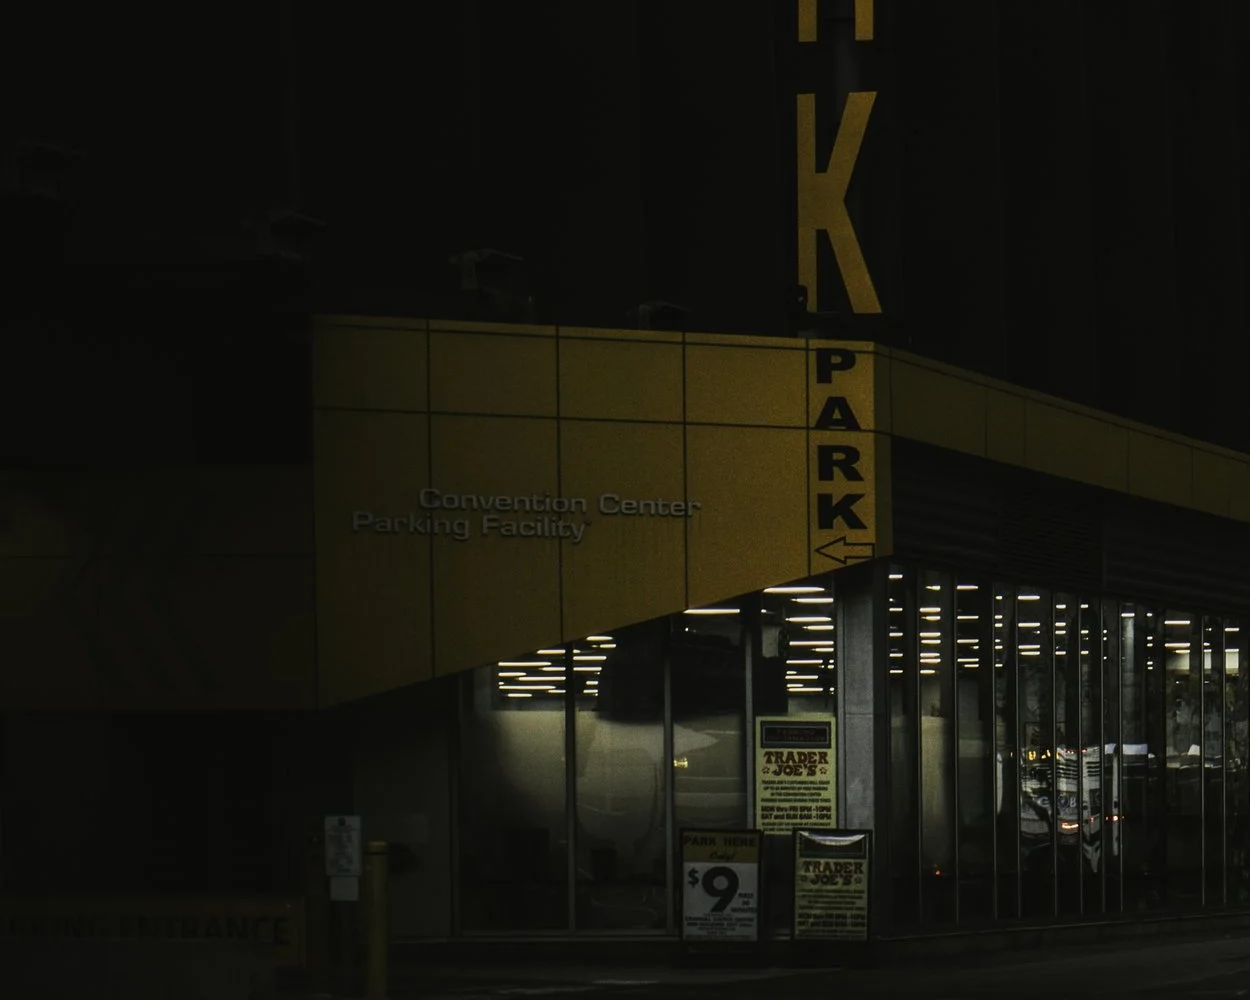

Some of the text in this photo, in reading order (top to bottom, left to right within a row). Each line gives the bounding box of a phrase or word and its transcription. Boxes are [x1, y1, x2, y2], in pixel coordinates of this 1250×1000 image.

[815, 347, 868, 530] PARK
[418, 487, 703, 518] Convention Center
[352, 510, 588, 544] Parking Facility
[763, 751, 829, 764] TRADER
[772, 764, 818, 777] JOE'S
[684, 836, 757, 847] PARK HERE
[802, 861, 864, 874] TRADER
[810, 874, 852, 885] JOE'S
